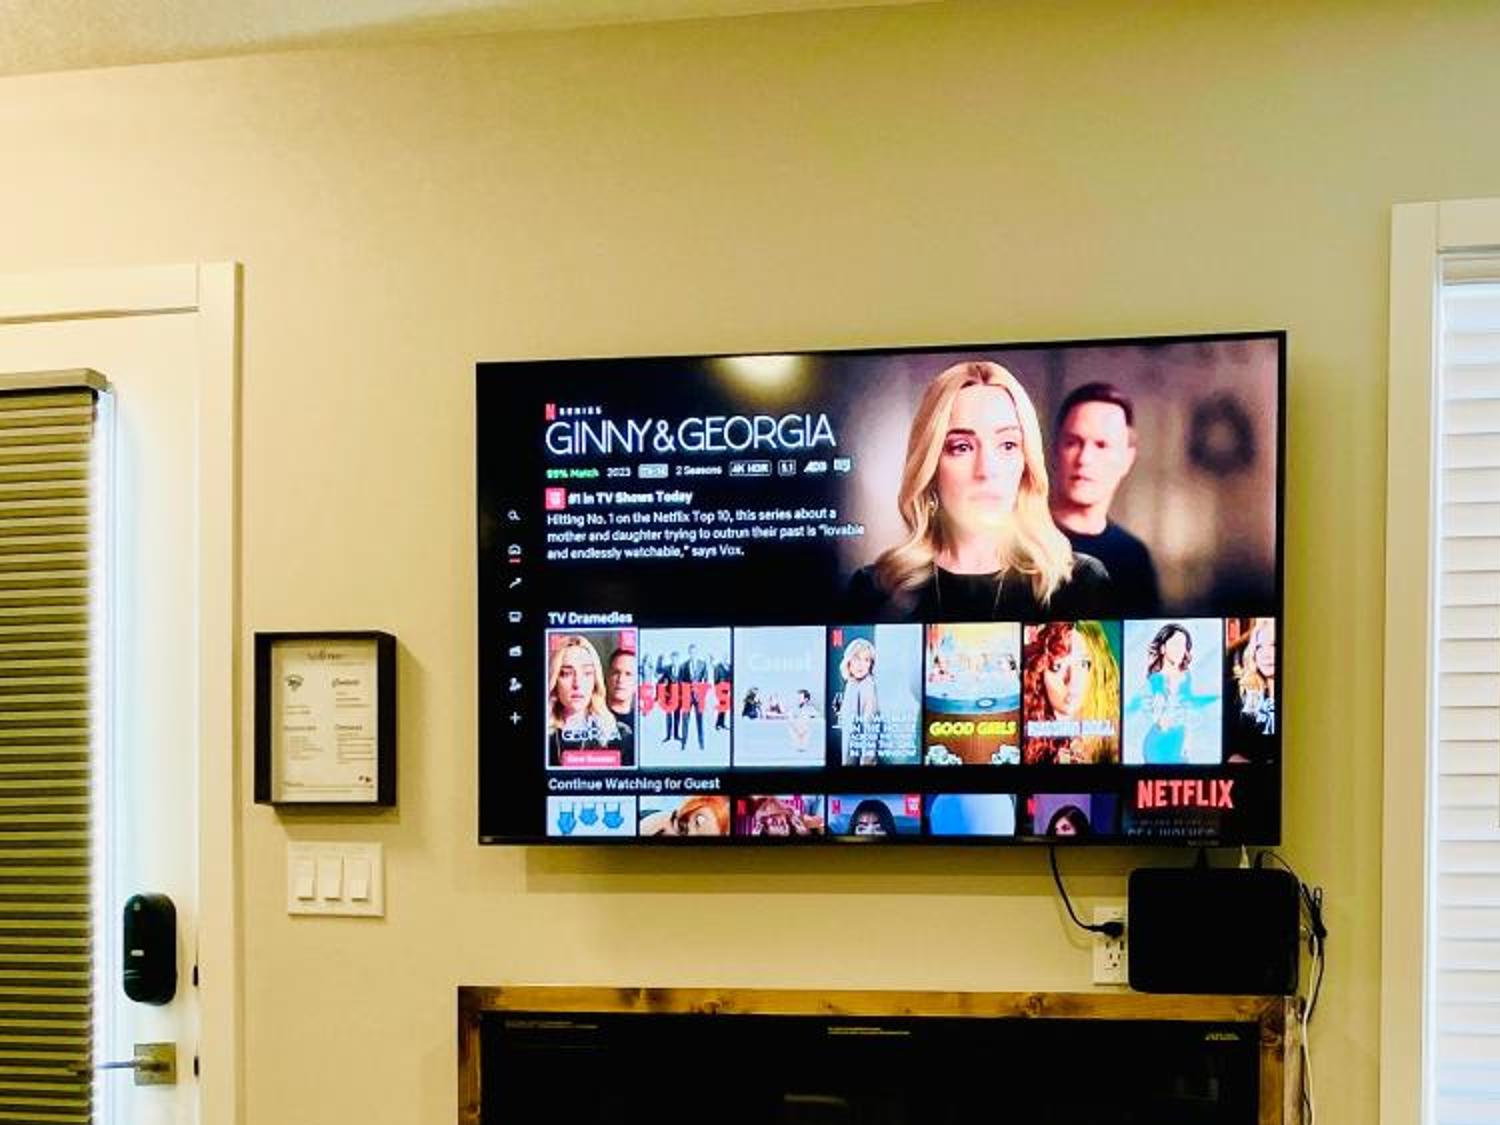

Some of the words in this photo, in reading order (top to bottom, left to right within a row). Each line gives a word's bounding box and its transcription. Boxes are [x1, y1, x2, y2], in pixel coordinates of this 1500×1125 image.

[583, 492, 595, 504] in
[596, 492, 613, 504] TV
[615, 491, 654, 503] Shows
[655, 489, 693, 505] Today
[547, 513, 585, 528] Hitting
[586, 513, 607, 525] No.
[615, 515, 631, 524] on
[632, 512, 651, 524] the
[653, 510, 691, 523] Netflix
[692, 510, 715, 524] Top
[717, 509, 734, 524] 10,
[735, 509, 757, 521] this
[758, 508, 793, 520] series
[794, 507, 827, 519] about
[547, 530, 586, 543] mother
[588, 529, 610, 542] and
[611, 528, 662, 543] daughter
[664, 527, 697, 543] trying
[698, 528, 711, 539] to
[713, 528, 750, 539] outrun
[751, 525, 777, 538] their
[779, 525, 805, 540] past
[806, 525, 817, 537] is
[547, 547, 569, 560] and
[570, 547, 623, 561] endlessly
[691, 546, 717, 559] says
[719, 544, 746, 556] Vox.
[547, 612, 566, 625] TV
[568, 611, 633, 624] Dramedies
[929, 720, 975, 737] GOOD
[976, 719, 1018, 736] GIRLS
[548, 778, 602, 791] Continue
[605, 777, 662, 793] Watching
[664, 777, 682, 790] for
[683, 776, 721, 790] Guest
[1137, 779, 1235, 809] NETFLIX
